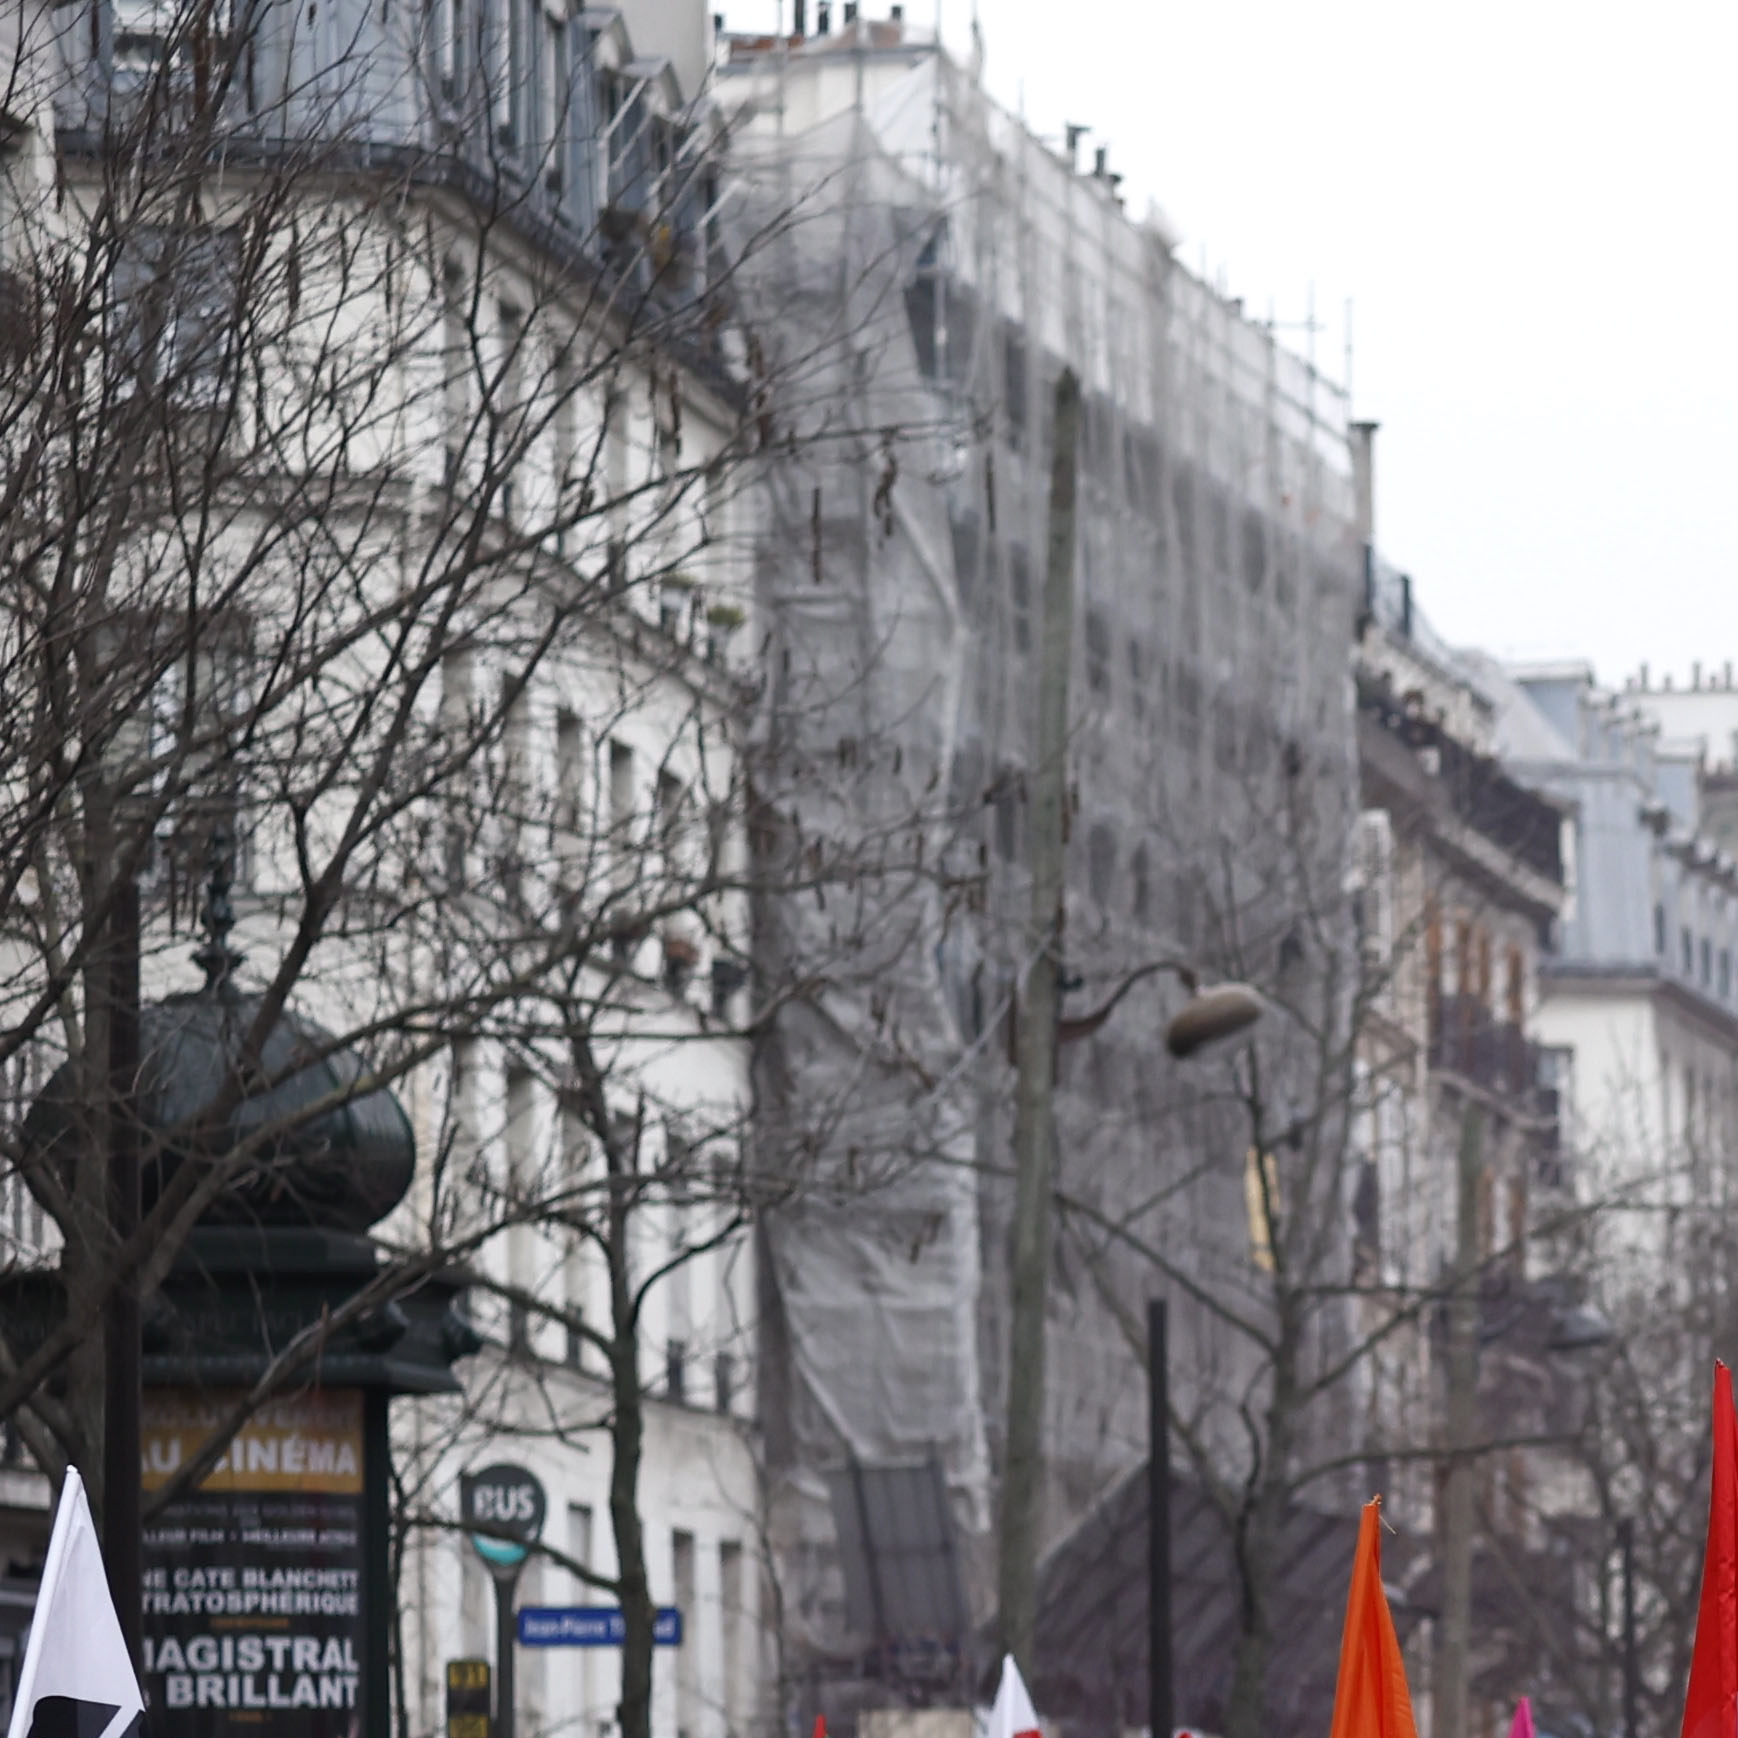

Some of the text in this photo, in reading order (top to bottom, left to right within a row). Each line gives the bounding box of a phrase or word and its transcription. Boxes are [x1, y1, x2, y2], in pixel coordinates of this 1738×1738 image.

[472, 1485, 536, 1522] BUS
[174, 1567, 236, 1589] CATE
[166, 1675, 359, 1708] BRILLANT
